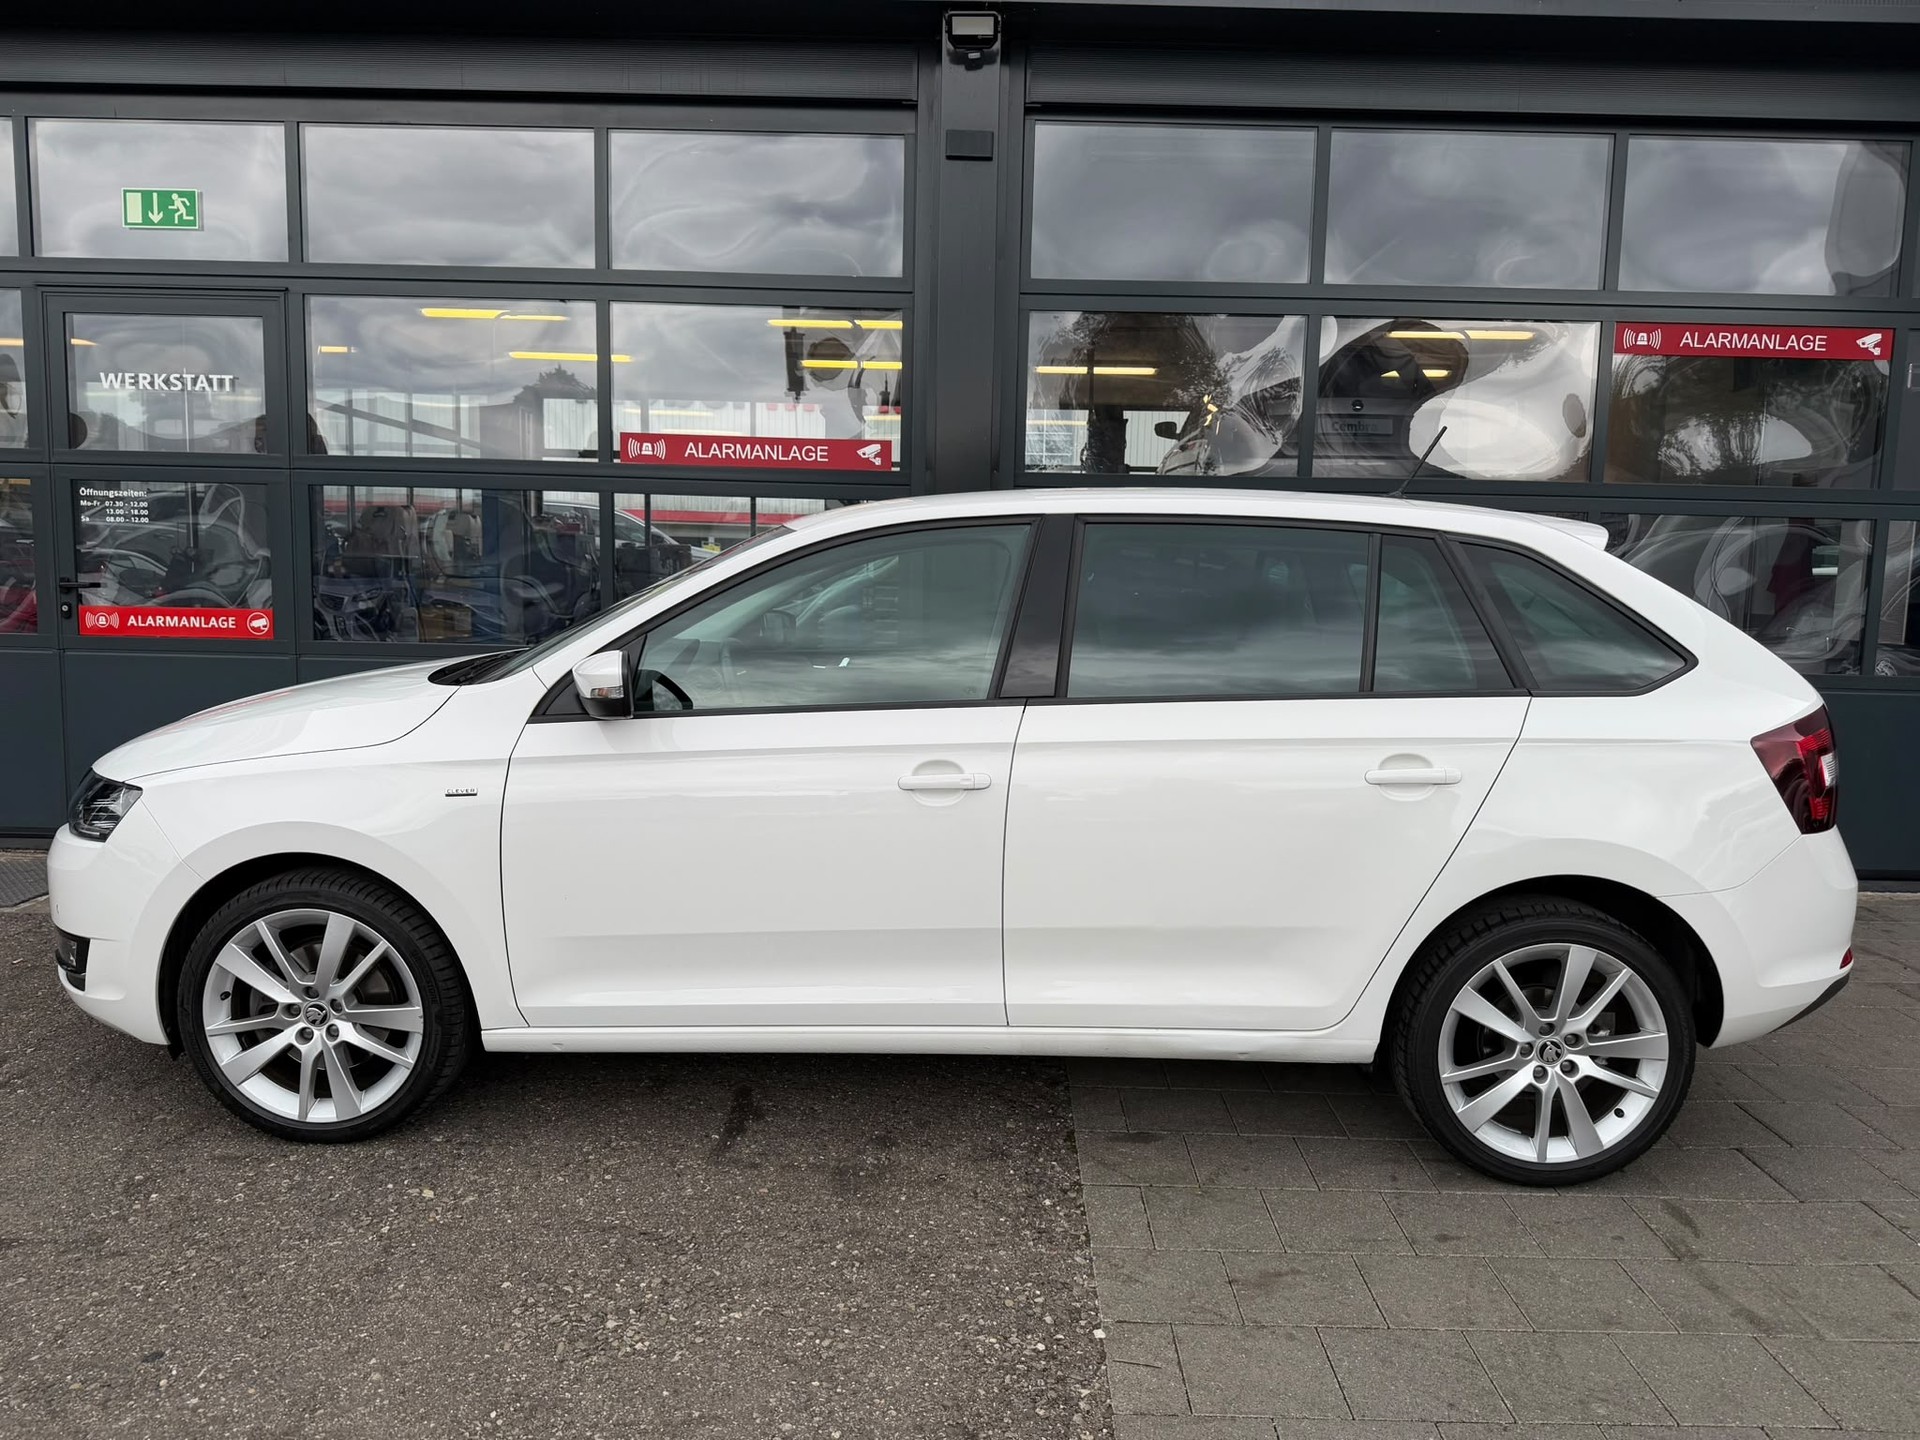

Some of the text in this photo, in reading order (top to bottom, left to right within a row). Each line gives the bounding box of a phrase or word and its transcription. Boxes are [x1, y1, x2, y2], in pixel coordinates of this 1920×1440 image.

[1679, 331, 1828, 351] ALARMANLAGE
[99, 372, 234, 392] WERKSTATT
[684, 442, 829, 462] ALARMANLAGE
[79, 486, 147, 498] Öffnungszeiten:
[80, 514, 90, 522] Sa
[127, 614, 236, 629] ALARMANLAGE
